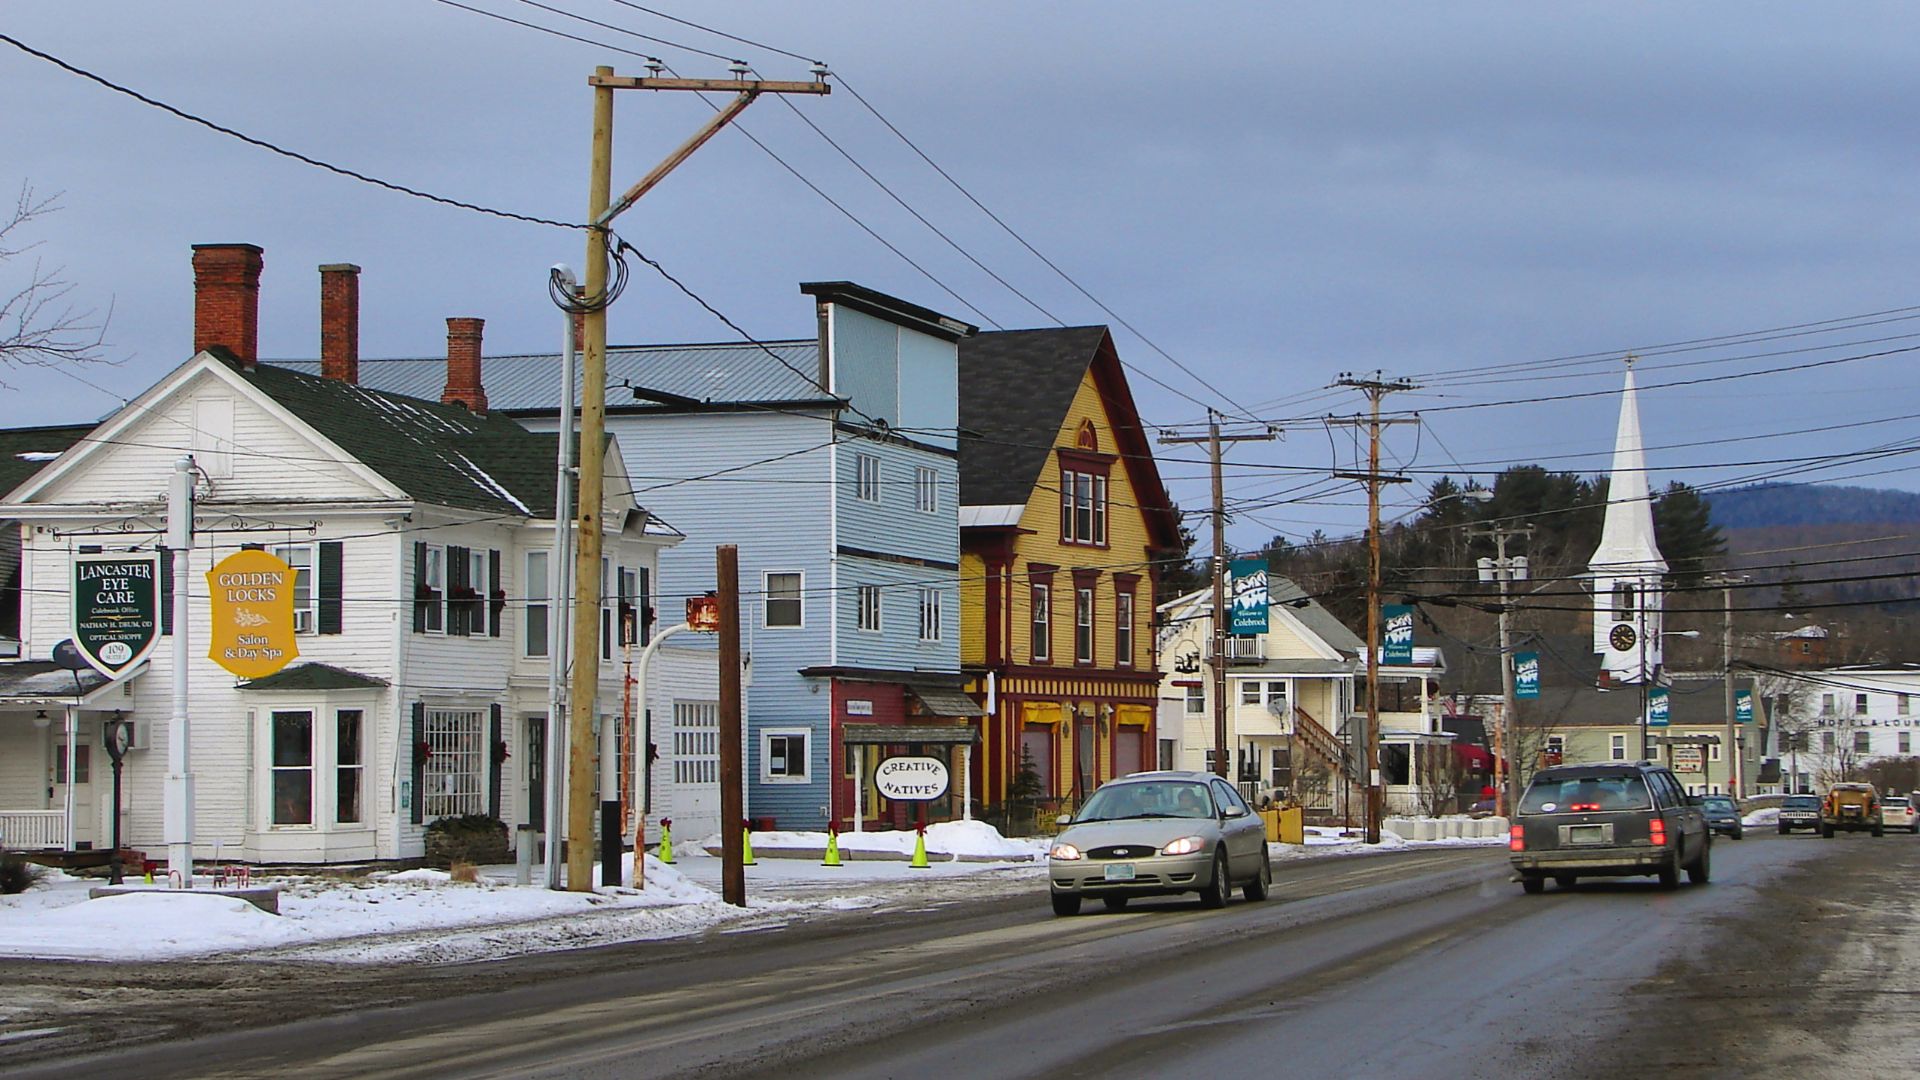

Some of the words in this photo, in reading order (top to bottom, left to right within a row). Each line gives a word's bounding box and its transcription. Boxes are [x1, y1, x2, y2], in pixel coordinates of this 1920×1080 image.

[80, 564, 151, 580] LANCASTER
[102, 578, 129, 590] EYE
[219, 572, 283, 587] GOLDEN
[96, 591, 135, 604] CARE
[227, 588, 276, 602] LOCKS
[1233, 617, 1266, 627] Colebrook
[237, 633, 269, 645] Salon
[108, 645, 124, 654] 109
[224, 648, 235, 658] &
[238, 647, 259, 661] Day
[262, 647, 283, 661] Spa
[883, 762, 941, 776] CREATIVE
[884, 782, 939, 794] NATIVES
